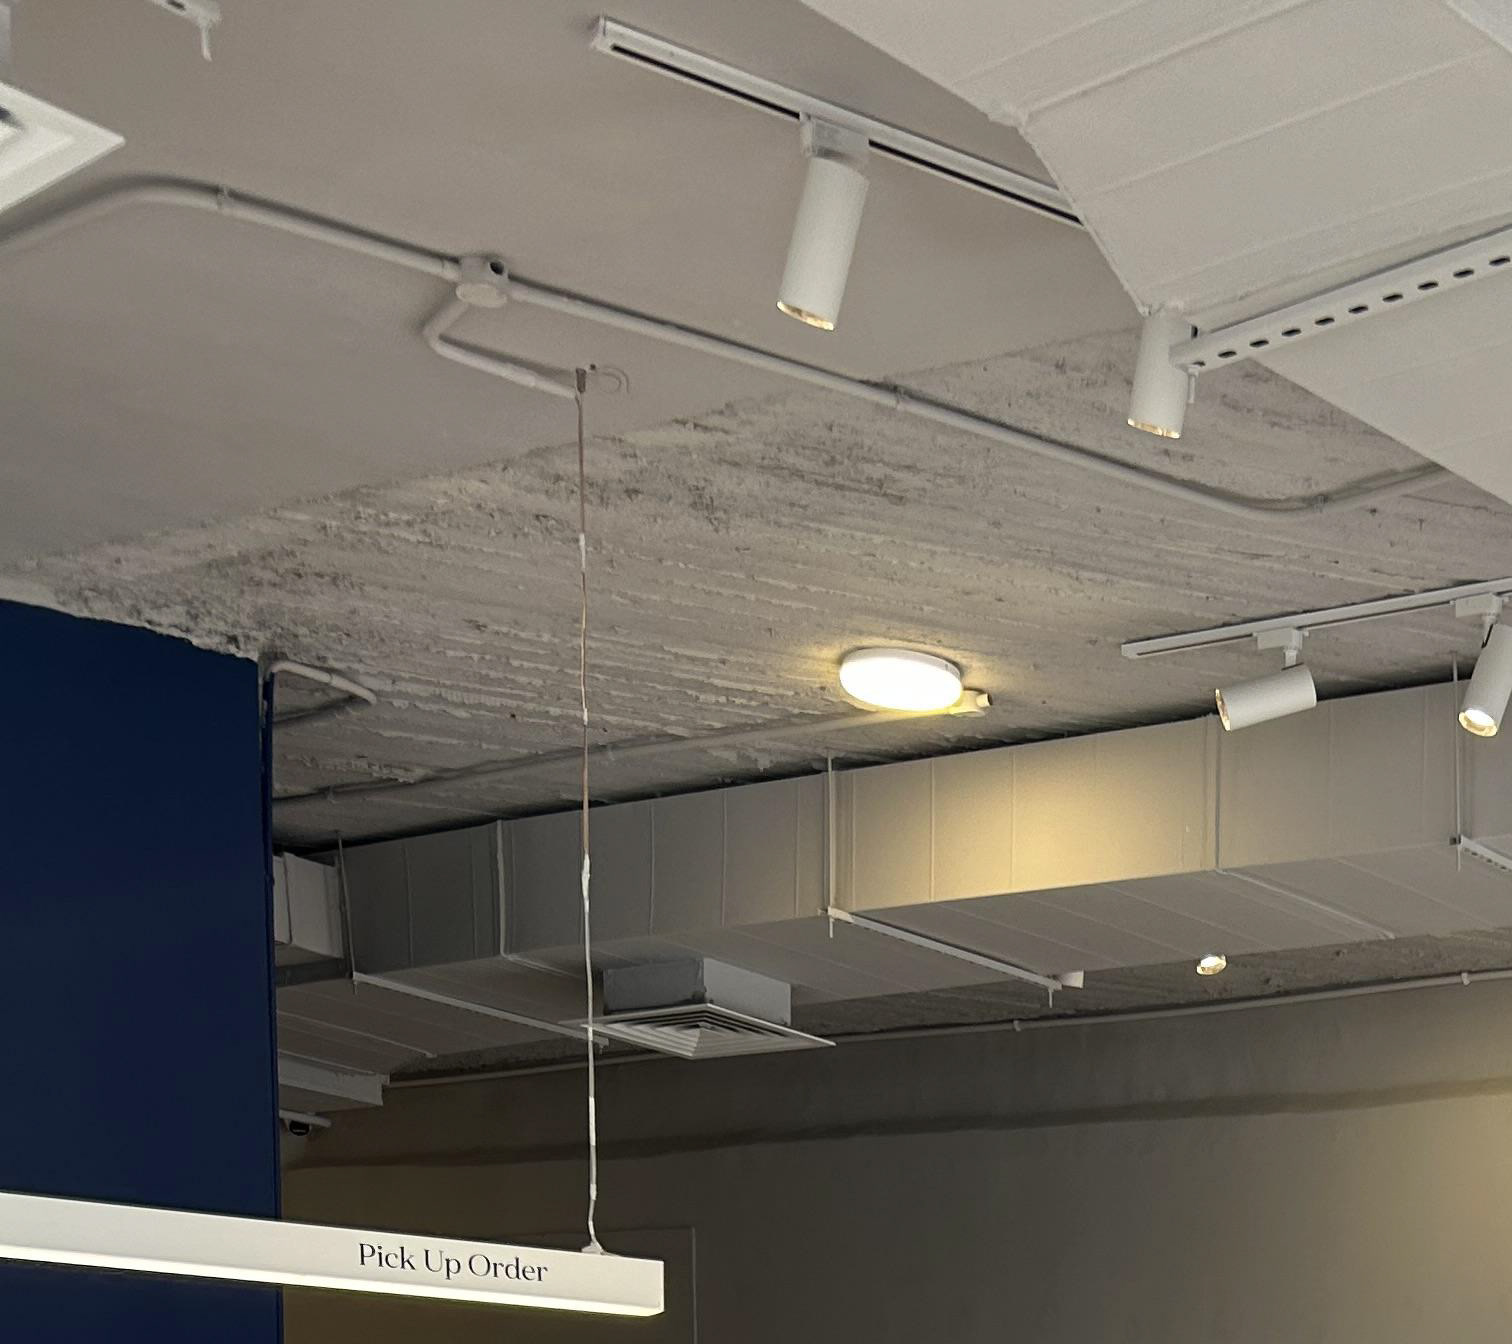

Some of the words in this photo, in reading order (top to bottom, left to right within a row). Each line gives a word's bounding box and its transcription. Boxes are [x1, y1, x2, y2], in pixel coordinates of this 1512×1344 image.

[358, 1242, 416, 1270] Pick
[424, 1248, 461, 1280] Up
[468, 1253, 548, 1282] Order
